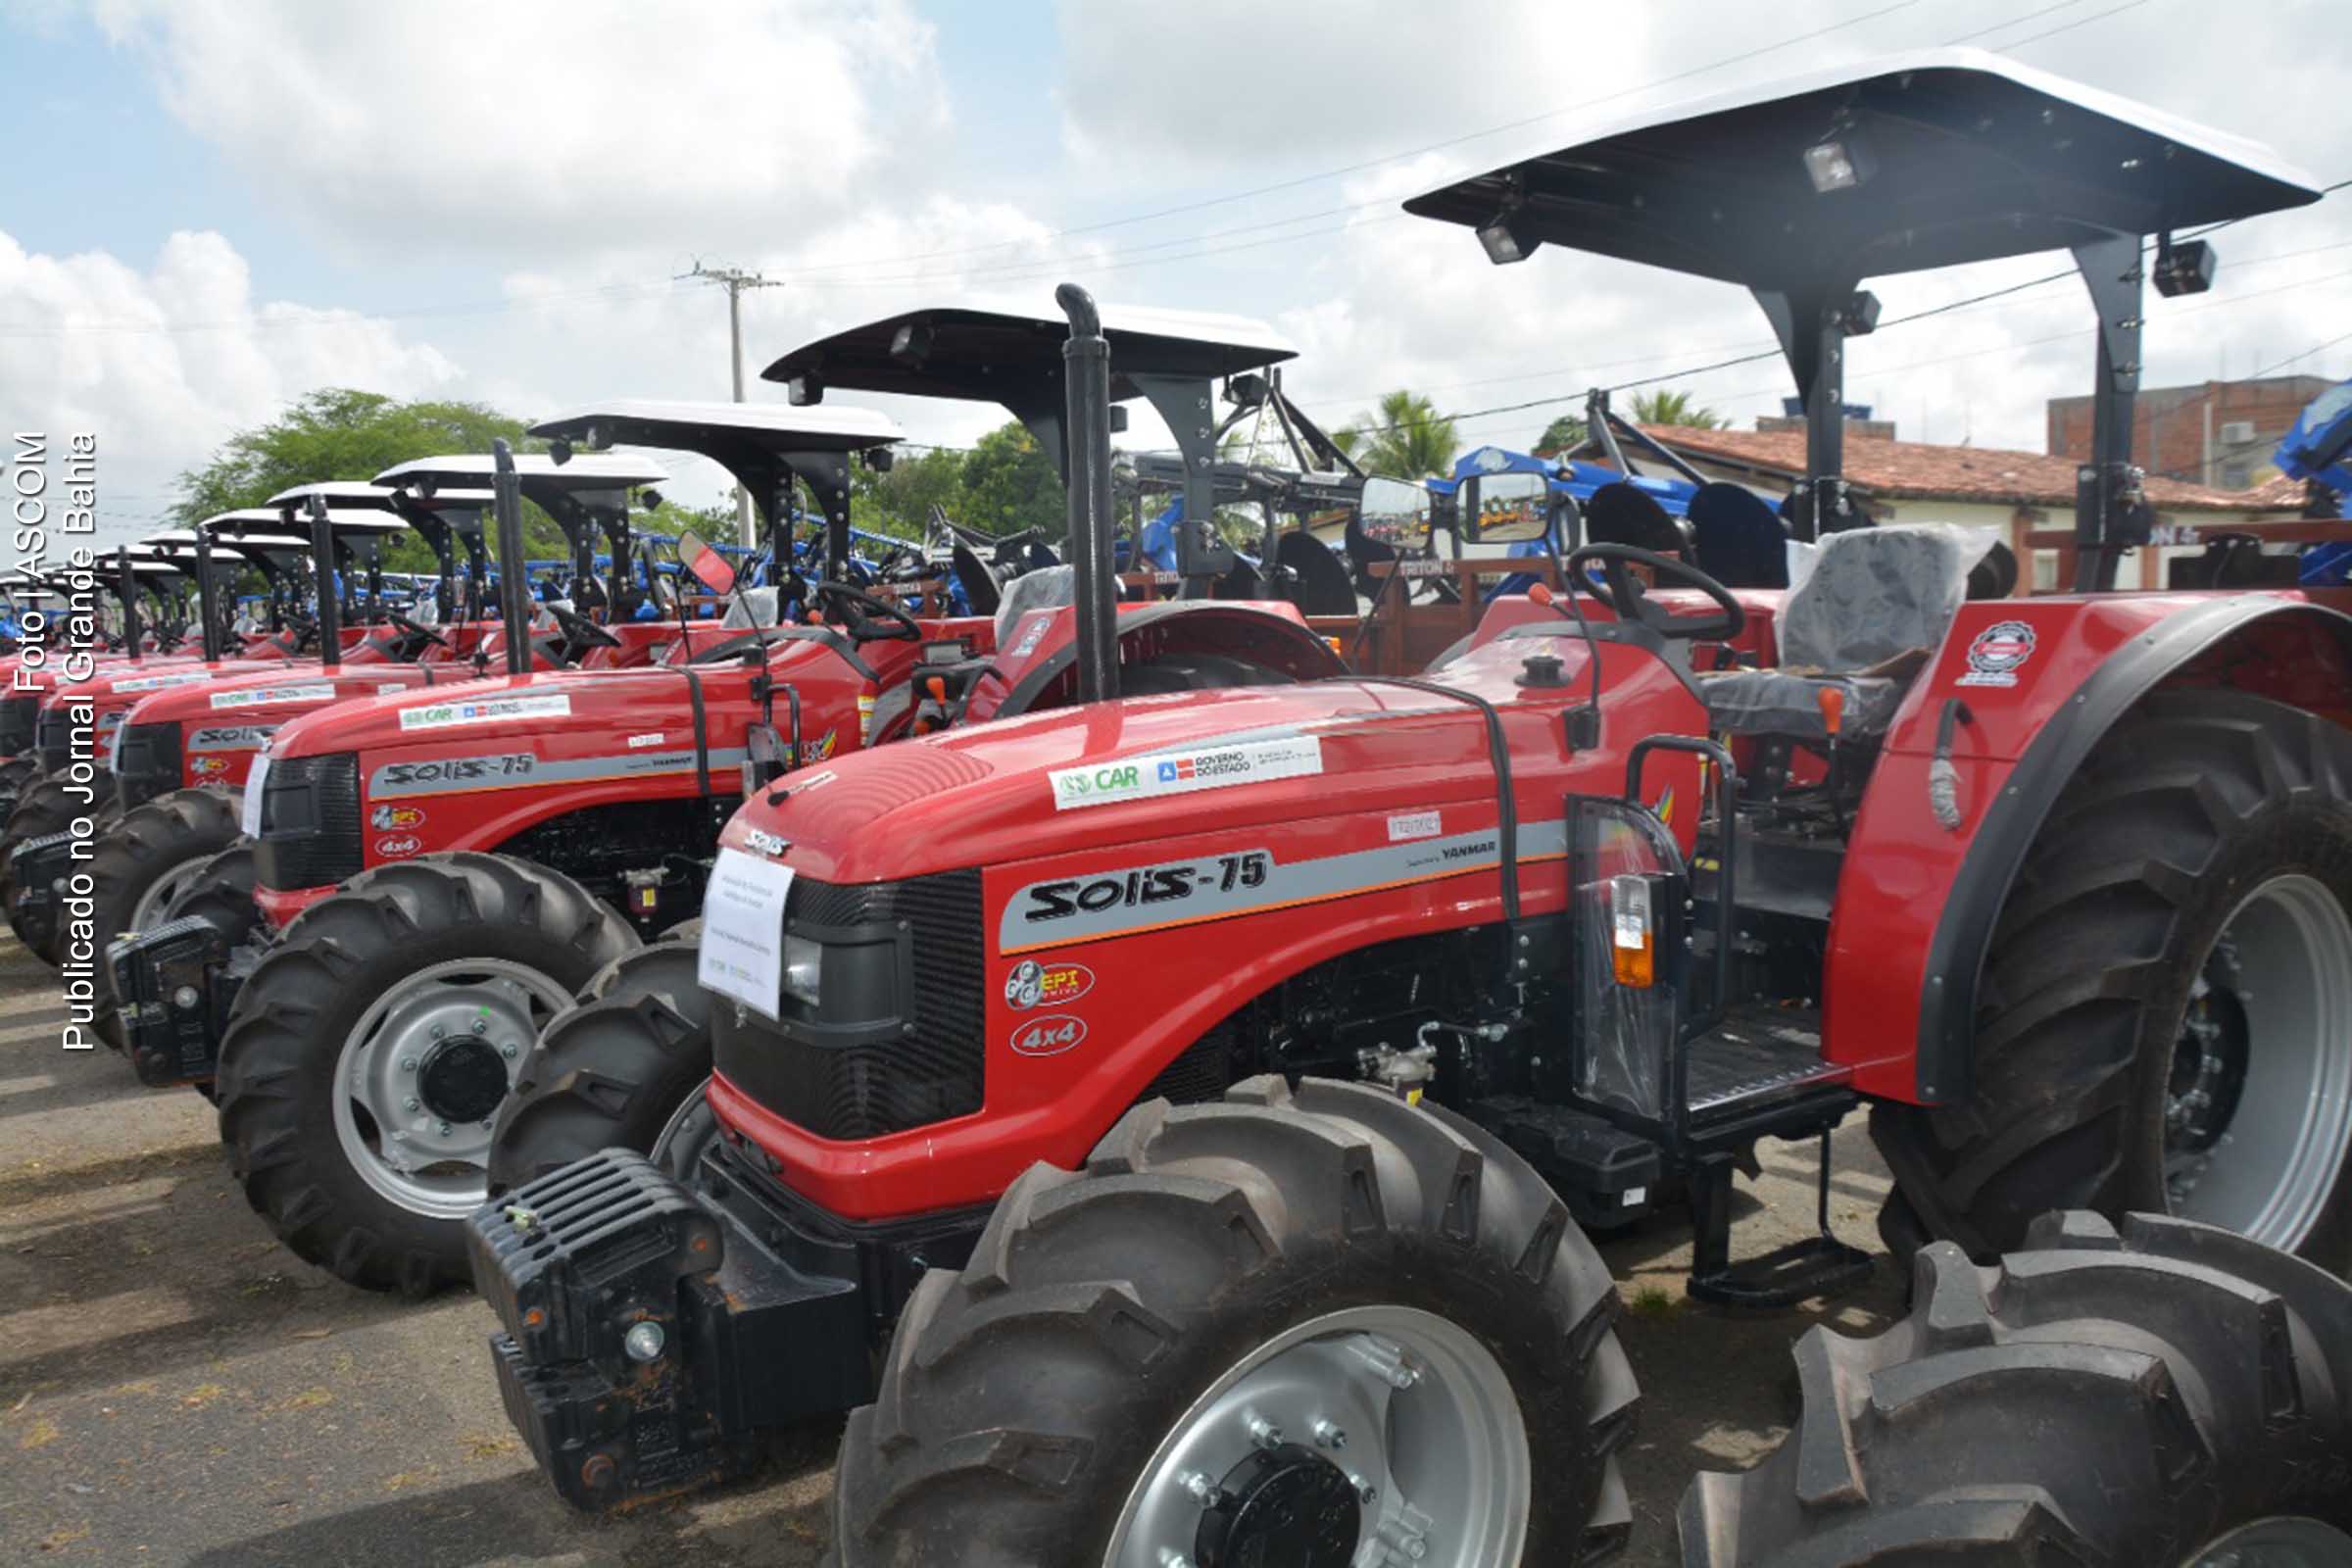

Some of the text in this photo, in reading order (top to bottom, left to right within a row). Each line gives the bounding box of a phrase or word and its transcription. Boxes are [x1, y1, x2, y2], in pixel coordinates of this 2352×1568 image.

[424, 708, 453, 722] CAR
[1195, 752, 1245, 766] GOVERNO
[1095, 766, 1140, 790] CAR
[1442, 841, 1495, 860] YANMAR
[1041, 970, 1078, 990] EPI
[1022, 1021, 1076, 1049] 4x4
